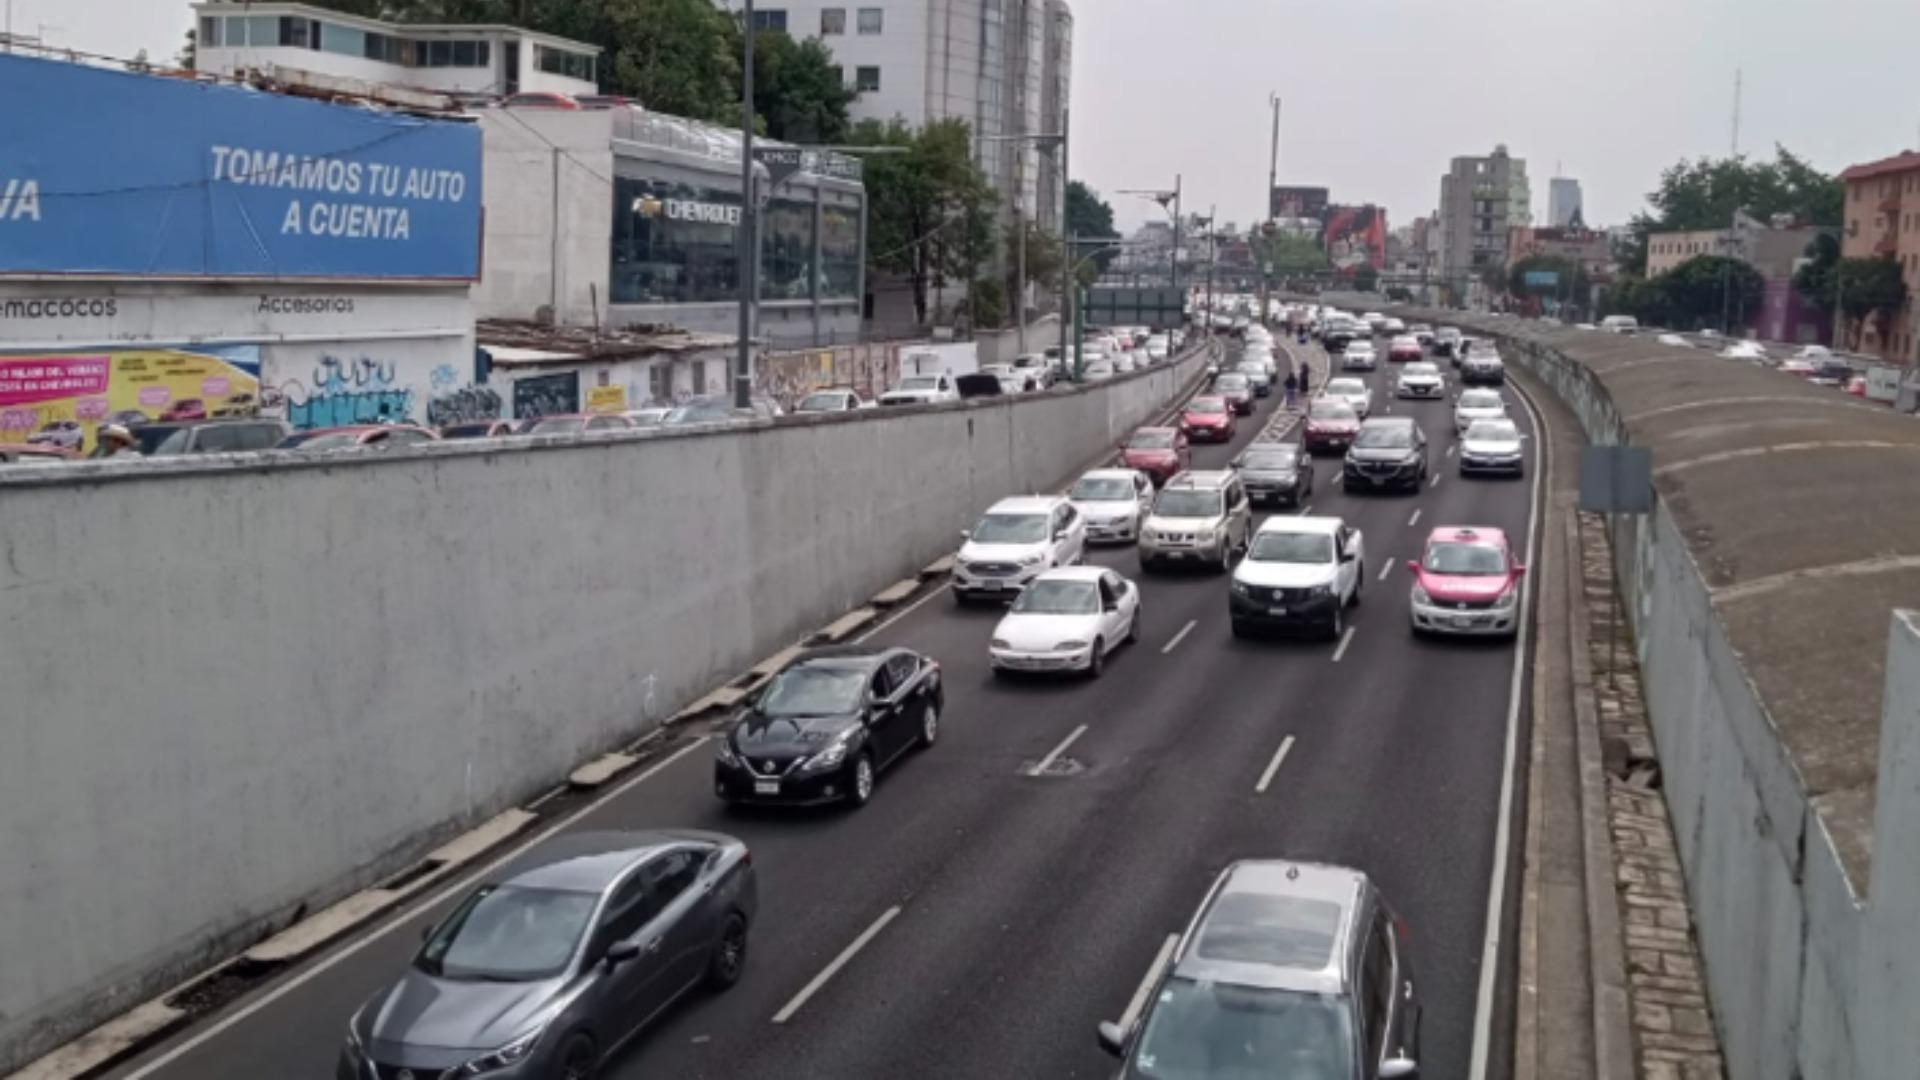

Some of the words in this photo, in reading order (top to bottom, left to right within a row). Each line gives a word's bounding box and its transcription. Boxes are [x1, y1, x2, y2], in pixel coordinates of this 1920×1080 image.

[211, 146, 362, 195] TOMAMOS
[368, 163, 401, 197] TU
[402, 168, 466, 202] AUTO
[280, 199, 302, 235] A
[308, 201, 411, 240] CUENTA
[258, 294, 355, 314] Accesorios
